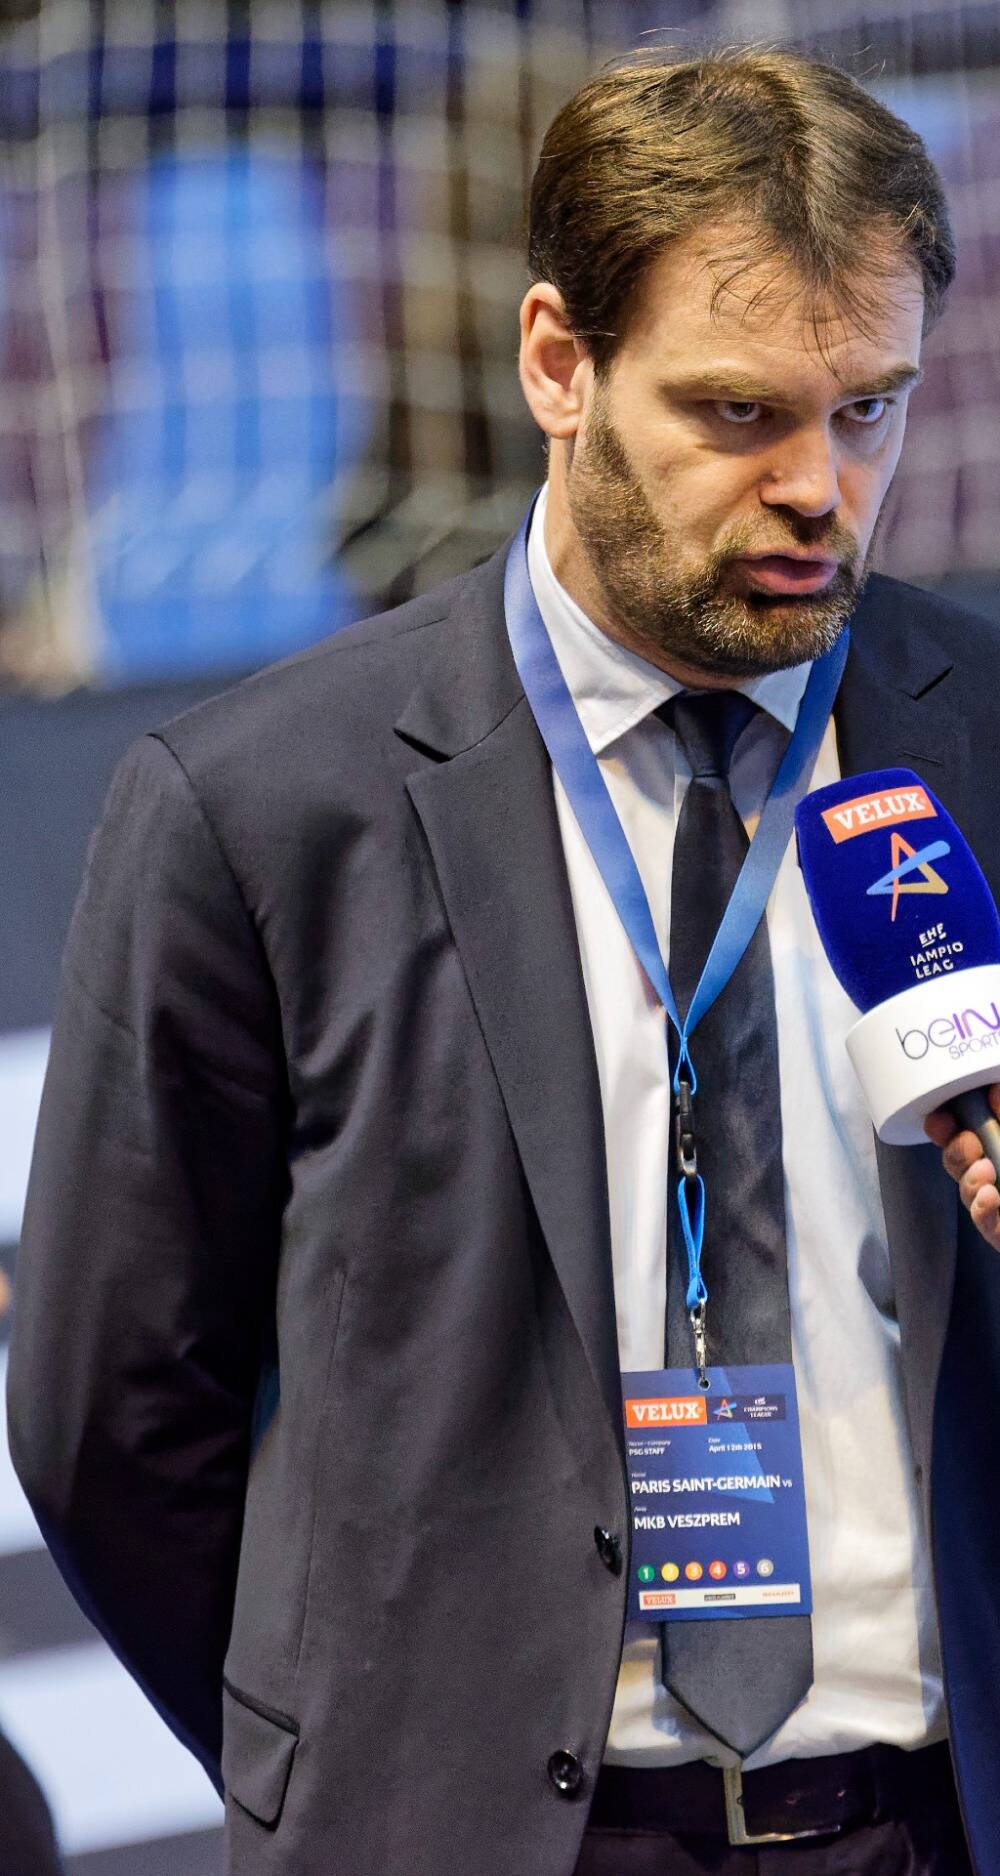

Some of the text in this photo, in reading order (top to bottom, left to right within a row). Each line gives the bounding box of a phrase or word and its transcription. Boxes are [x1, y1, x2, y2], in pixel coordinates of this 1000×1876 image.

[833, 792, 927, 830] VELUX
[632, 1402, 700, 1422] VELUX
[628, 1447, 666, 1456] PSG STAFF
[708, 1444, 726, 1453] April
[631, 1479, 671, 1494] PARIS
[672, 1474, 781, 1493] SAINT-GERMAIN
[634, 1511, 741, 1530] MKB VESZPREM
